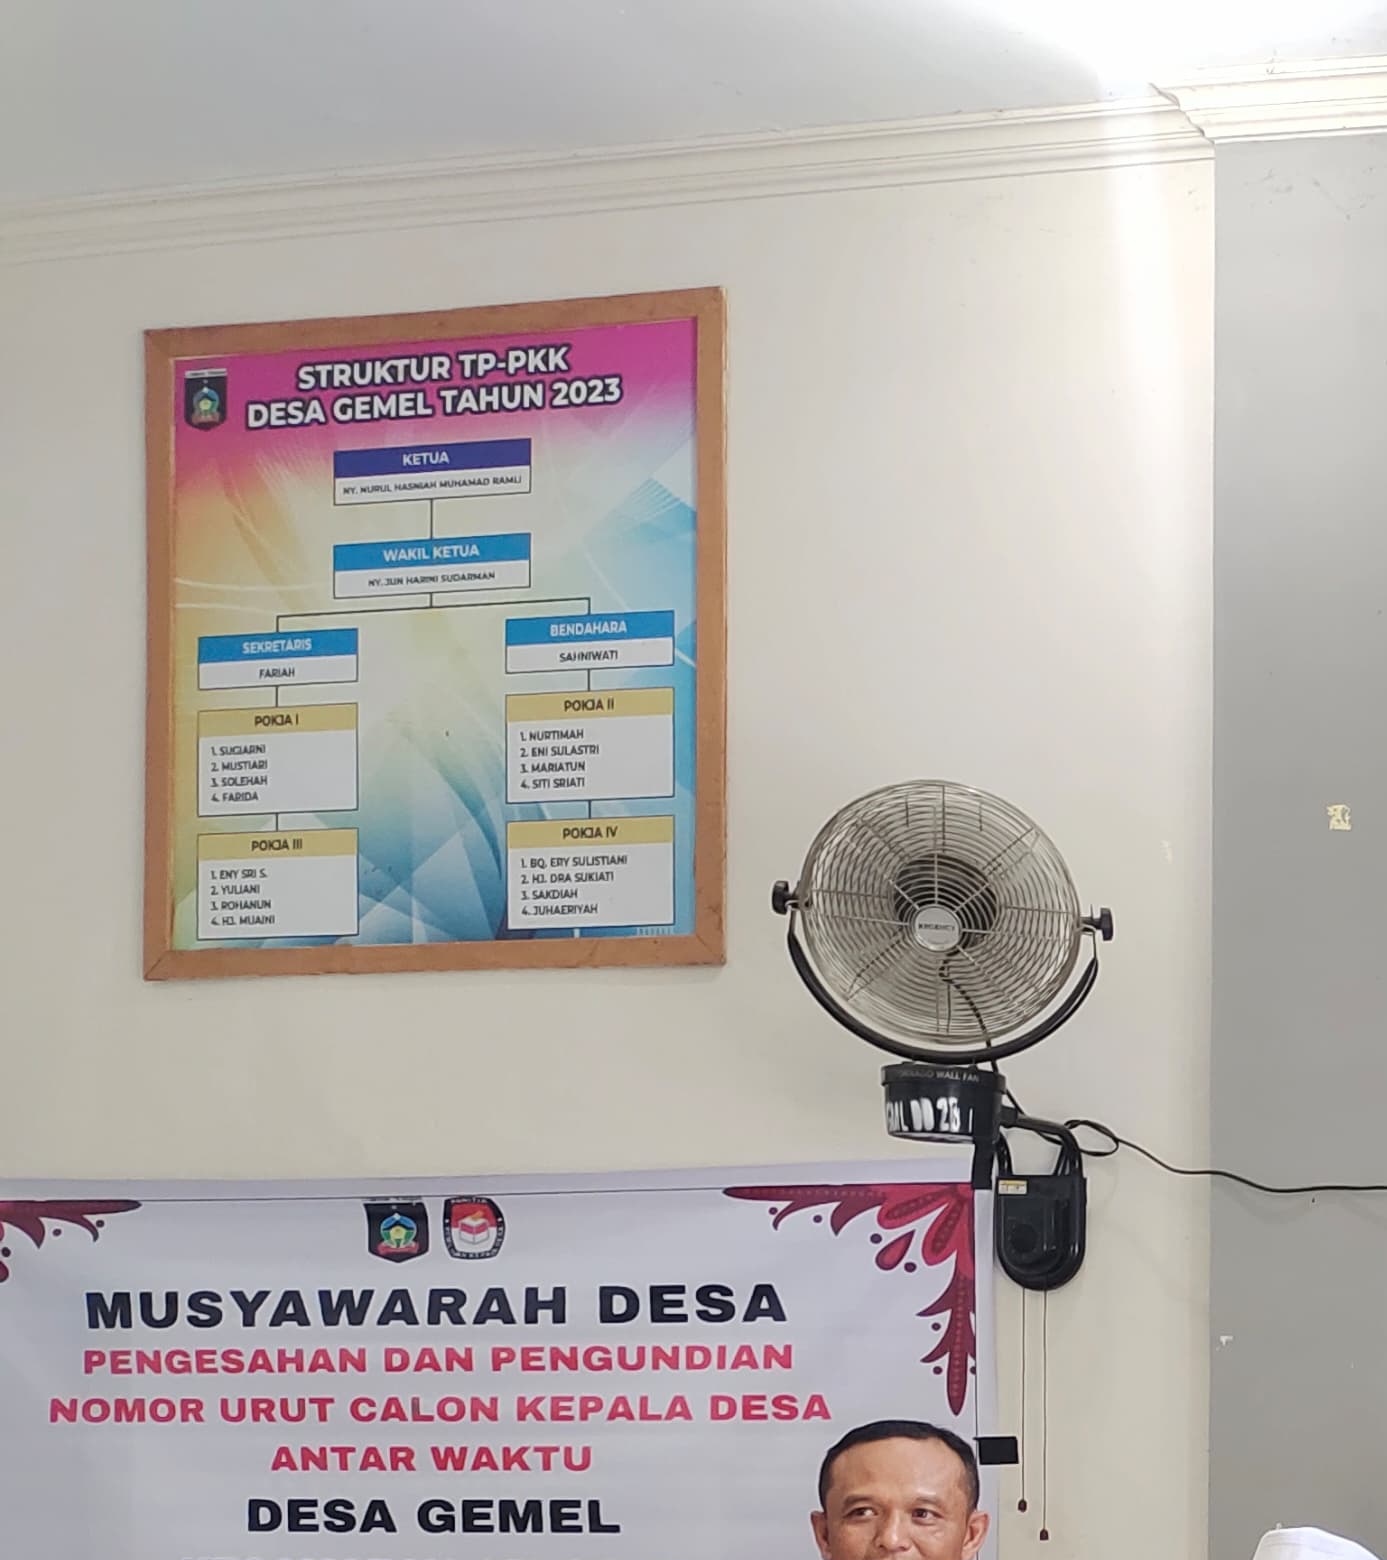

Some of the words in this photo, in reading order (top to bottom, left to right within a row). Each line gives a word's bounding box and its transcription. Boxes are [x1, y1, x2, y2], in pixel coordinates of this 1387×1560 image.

[298, 355, 450, 390] STRUKTUR
[459, 346, 569, 379] TP-PKK
[247, 402, 326, 429] DESA
[334, 393, 432, 423] GEMEL
[440, 385, 543, 417] TAHUN
[552, 378, 621, 406] 2023
[403, 451, 449, 466] KETUA
[383, 549, 429, 562] WAKIL
[433, 545, 480, 559] KETUA
[550, 621, 627, 636] BENDAHARA
[242, 639, 312, 654] SEKRETARIS
[564, 700, 603, 711] POKJA
[607, 699, 614, 709] II
[255, 715, 292, 726] POKJA
[563, 827, 603, 839] POKJA
[606, 826, 618, 837] IV
[252, 840, 289, 851] POKJA
[293, 839, 302, 849] III
[85, 1287, 566, 1330] MUSYAWARAH
[598, 1283, 787, 1325] DESA
[83, 1347, 368, 1376] PENGESAHAN
[383, 1345, 474, 1373] DAN
[489, 1343, 794, 1372] PENGUNDIAN
[48, 1397, 205, 1425] NOMOR
[220, 1397, 331, 1423] URUT
[349, 1395, 501, 1423] CALON
[516, 1394, 695, 1422] KEPALA
[709, 1394, 830, 1421] DESA
[270, 1446, 416, 1472] ANTAR
[430, 1444, 592, 1473] WAKTU
[246, 1498, 397, 1533] DESA
[416, 1498, 621, 1533] GEMEL
